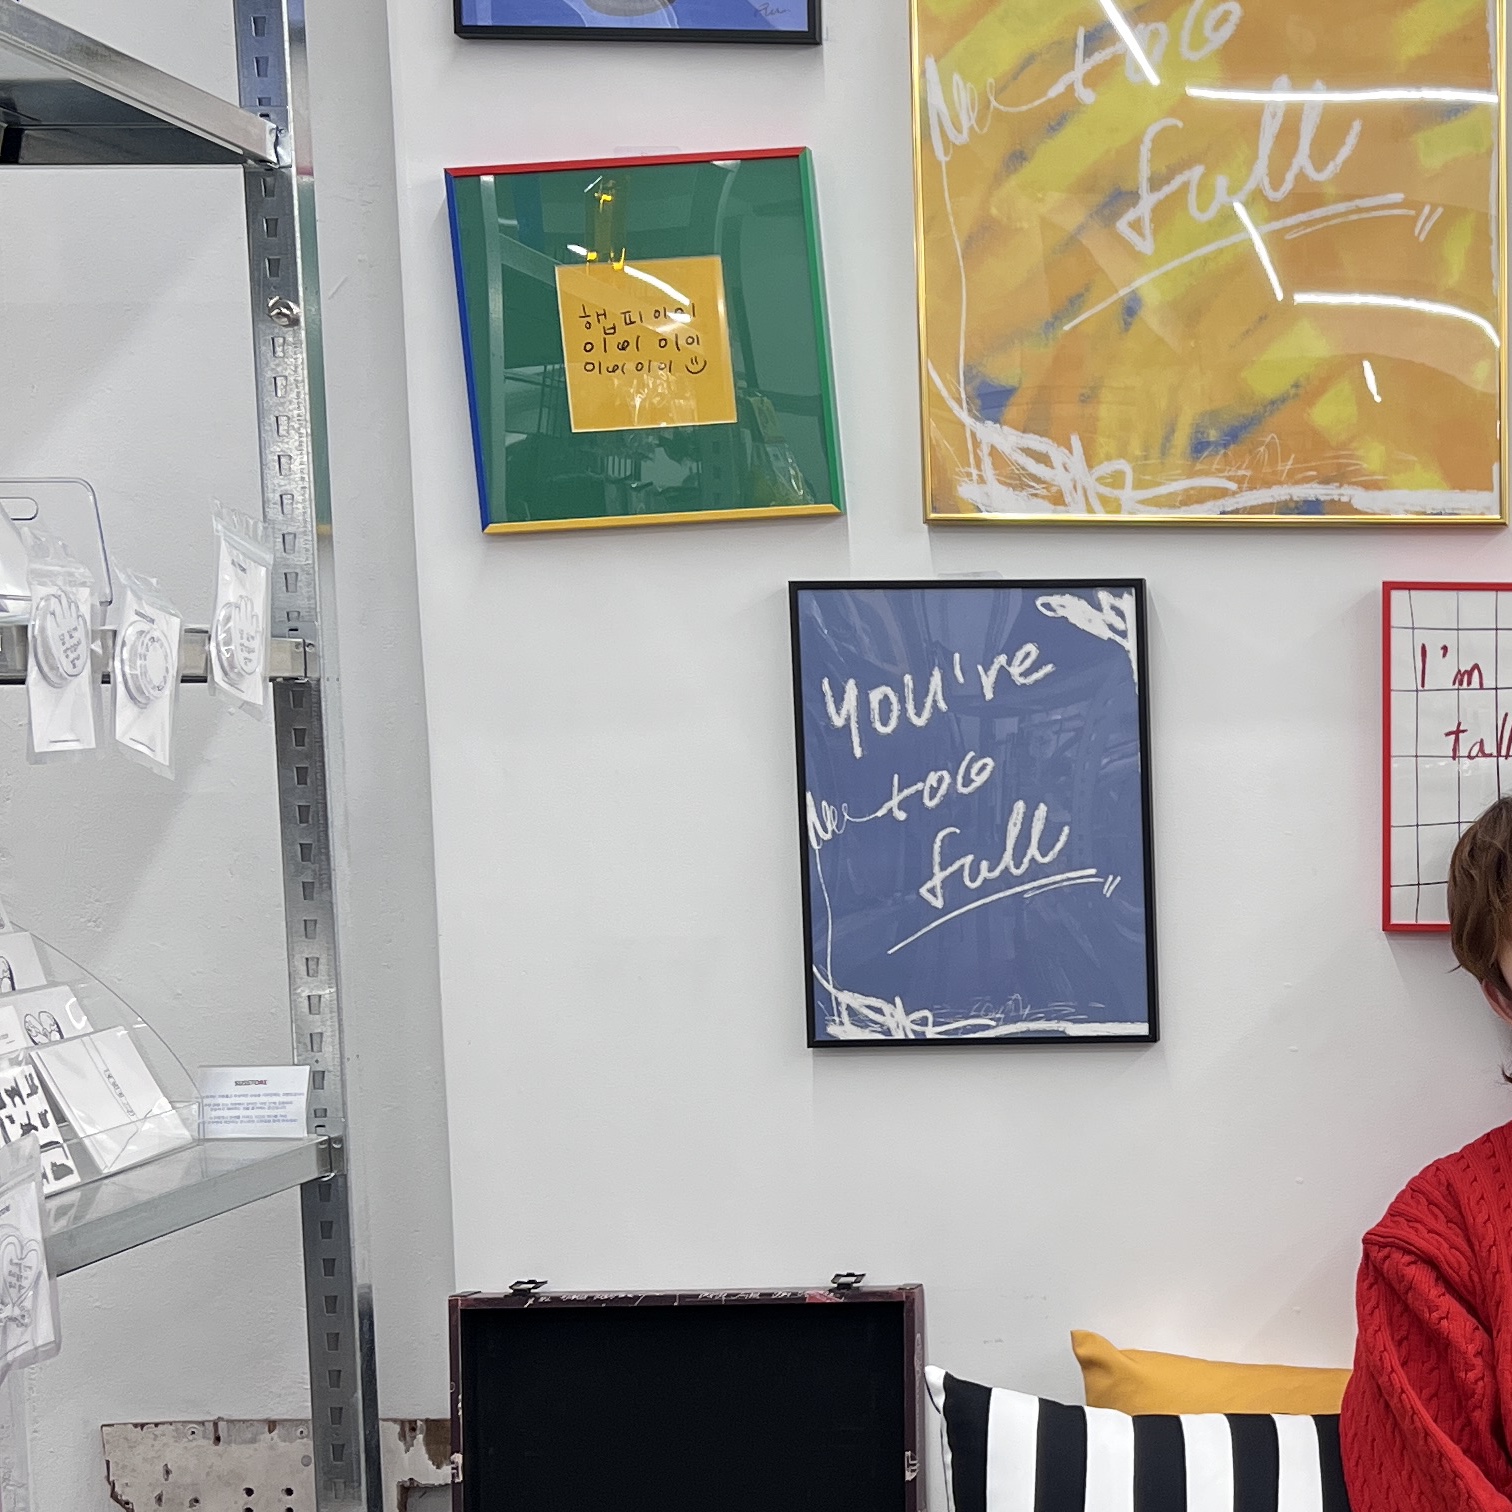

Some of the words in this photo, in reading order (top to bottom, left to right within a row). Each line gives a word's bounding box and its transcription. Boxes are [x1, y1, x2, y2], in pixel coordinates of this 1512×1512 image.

[1117, 75, 1363, 255] full
[1420, 642, 1484, 689] I'm
[919, 799, 1071, 909] full
